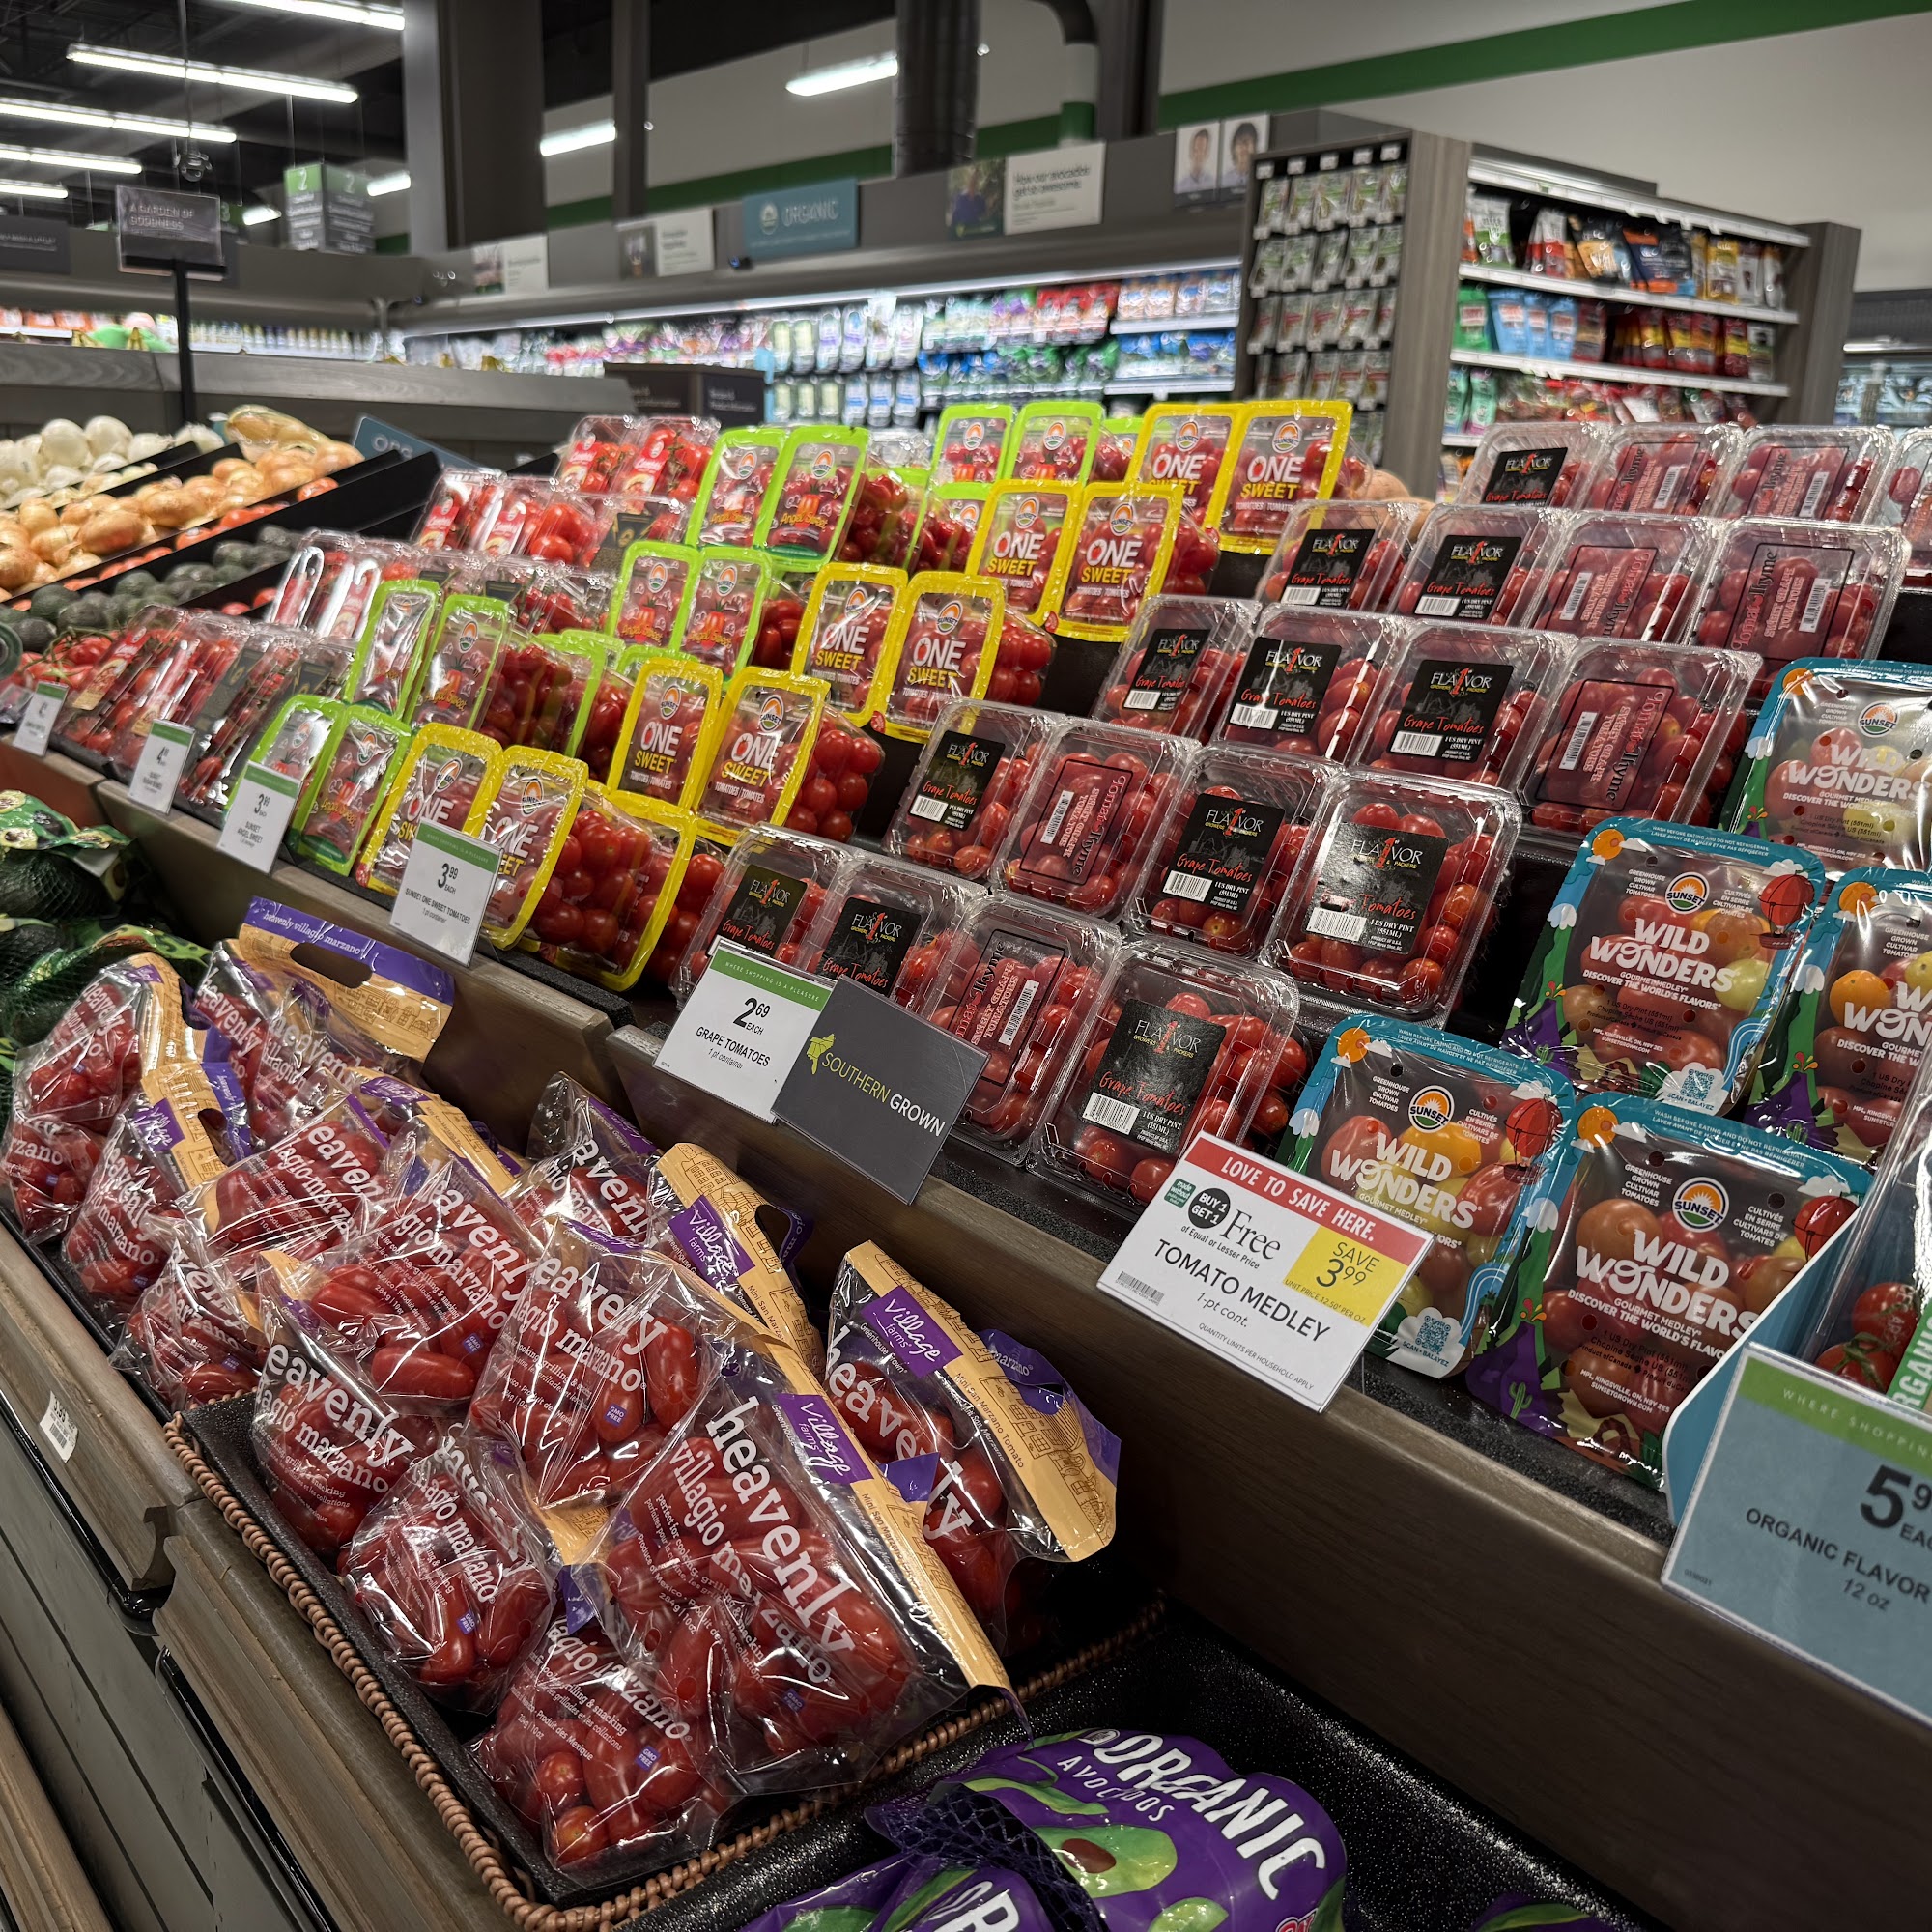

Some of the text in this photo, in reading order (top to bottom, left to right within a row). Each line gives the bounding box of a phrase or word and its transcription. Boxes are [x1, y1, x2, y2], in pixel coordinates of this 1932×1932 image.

[1151, 454, 1207, 480] ONE
[1247, 455, 1304, 484] ONE
[1240, 482, 1297, 500] SWEET
[993, 532, 1045, 560] ONE
[1087, 539, 1143, 569] ONE
[987, 559, 1037, 577] SWEET
[822, 623, 869, 655] ONE
[815, 651, 864, 670] SWEET
[913, 637, 966, 670] ONE
[907, 667, 958, 688] SWEET
[1404, 715, 1485, 734] Grape Tomatoes
[641, 722, 683, 757] ONE
[731, 733, 783, 771] ONE
[635, 751, 674, 774] SWEET
[722, 762, 769, 788] SWEET
[1177, 853, 1252, 883] Grape Tomatoes
[1360, 894, 1416, 920] Tomatoes
[1666, 891, 1705, 906] SUNSET
[722, 919, 774, 950] Grape Tomatoes
[1634, 918, 1710, 955] WILD
[1590, 935, 1740, 993] WONDERS
[746, 969, 774, 984] SHOPPING
[790, 985, 820, 1002] PLEASURE
[1582, 970, 1624, 986] DISCOVER
[1624, 980, 1640, 991] THE
[746, 1023, 764, 1036] EACH
[696, 1026, 771, 1067] GRAPE TOMATOES
[719, 1054, 745, 1069] container
[821, 1051, 945, 1137] SOUTHERN GROWN
[1099, 1070, 1186, 1116] Grape Tomatoes
[1372, 1091, 1399, 1104] CULTIVAR
[1373, 1075, 1410, 1094] GREENHOUSE
[1377, 1085, 1399, 1097] GROWN
[1369, 1097, 1399, 1113] TOMATOES
[1409, 1106, 1449, 1125] SUNSET
[1376, 1131, 1452, 1182] WILD
[1624, 1164, 1673, 1185] GREENHOUSE
[1631, 1175, 1660, 1189] GROWN
[1221, 1156, 1376, 1242] LOVE TO SAVE HERE.
[1329, 1149, 1475, 1229] WONDERS
[1359, 1193, 1395, 1211] GOURMET
[1621, 1188, 1660, 1207] TOMATOES
[1625, 1181, 1660, 1198] CULTIVAR
[1191, 1205, 1220, 1225] GET 1
[1199, 1193, 1228, 1213] BUY 1
[1674, 1201, 1722, 1224] SUNSET
[1747, 1205, 1784, 1223] CULTIVÉS
[1219, 1208, 1281, 1260] Free
[1733, 1219, 1774, 1239] CULTIVARS
[1744, 1213, 1781, 1231] EN SERRE
[1189, 1228, 1209, 1243] Equal
[1217, 1242, 1240, 1260] Lesser
[1240, 1255, 1261, 1269] Price
[1740, 1230, 1776, 1247] TOMATES
[1333, 1241, 1379, 1273] SAVE
[1634, 1228, 1730, 1290] WILD
[1153, 1239, 1240, 1295] TOMATO
[1241, 1286, 1331, 1344] MEDLEY
[1285, 1279, 1301, 1293] UNIT
[1301, 1287, 1321, 1300] PRICE
[1341, 1306, 1354, 1318] PER
[1197, 1291, 1248, 1328] 1-pt cont.
[1568, 1289, 1618, 1318] DISCOVER
[1619, 1309, 1639, 1326] THE
[1640, 1320, 1690, 1347] WORLD'S
[1614, 1297, 1660, 1322] GOURMET
[860, 1322, 888, 1355] Greenhouse
[885, 1298, 941, 1362] Village
[1199, 1323, 1314, 1391] QUANTITY LIMITS PER HOUSEHOLD APPLY
[1401, 1340, 1424, 1357] SCAN
[607, 1411, 622, 1424] FREE
[610, 1406, 625, 1417] GMO
[1782, 1388, 1932, 1459] WHERE SHOPPIN
[979, 1400, 1004, 1434] Marzano
[1002, 1435, 1024, 1469] Tomato
[668, 1440, 728, 1547] villagio
[705, 1396, 856, 1655] heavenly
[1746, 1508, 1932, 1605] ORGANIC FLAVOR
[1842, 1578, 1865, 1600] 12
[592, 1702, 628, 1737] snacking
[566, 1735, 594, 1761] Mexique
[638, 1753, 654, 1768] FREE
[642, 1747, 658, 1760] GMO
[1056, 1755, 1175, 1823] AVOCADOS
